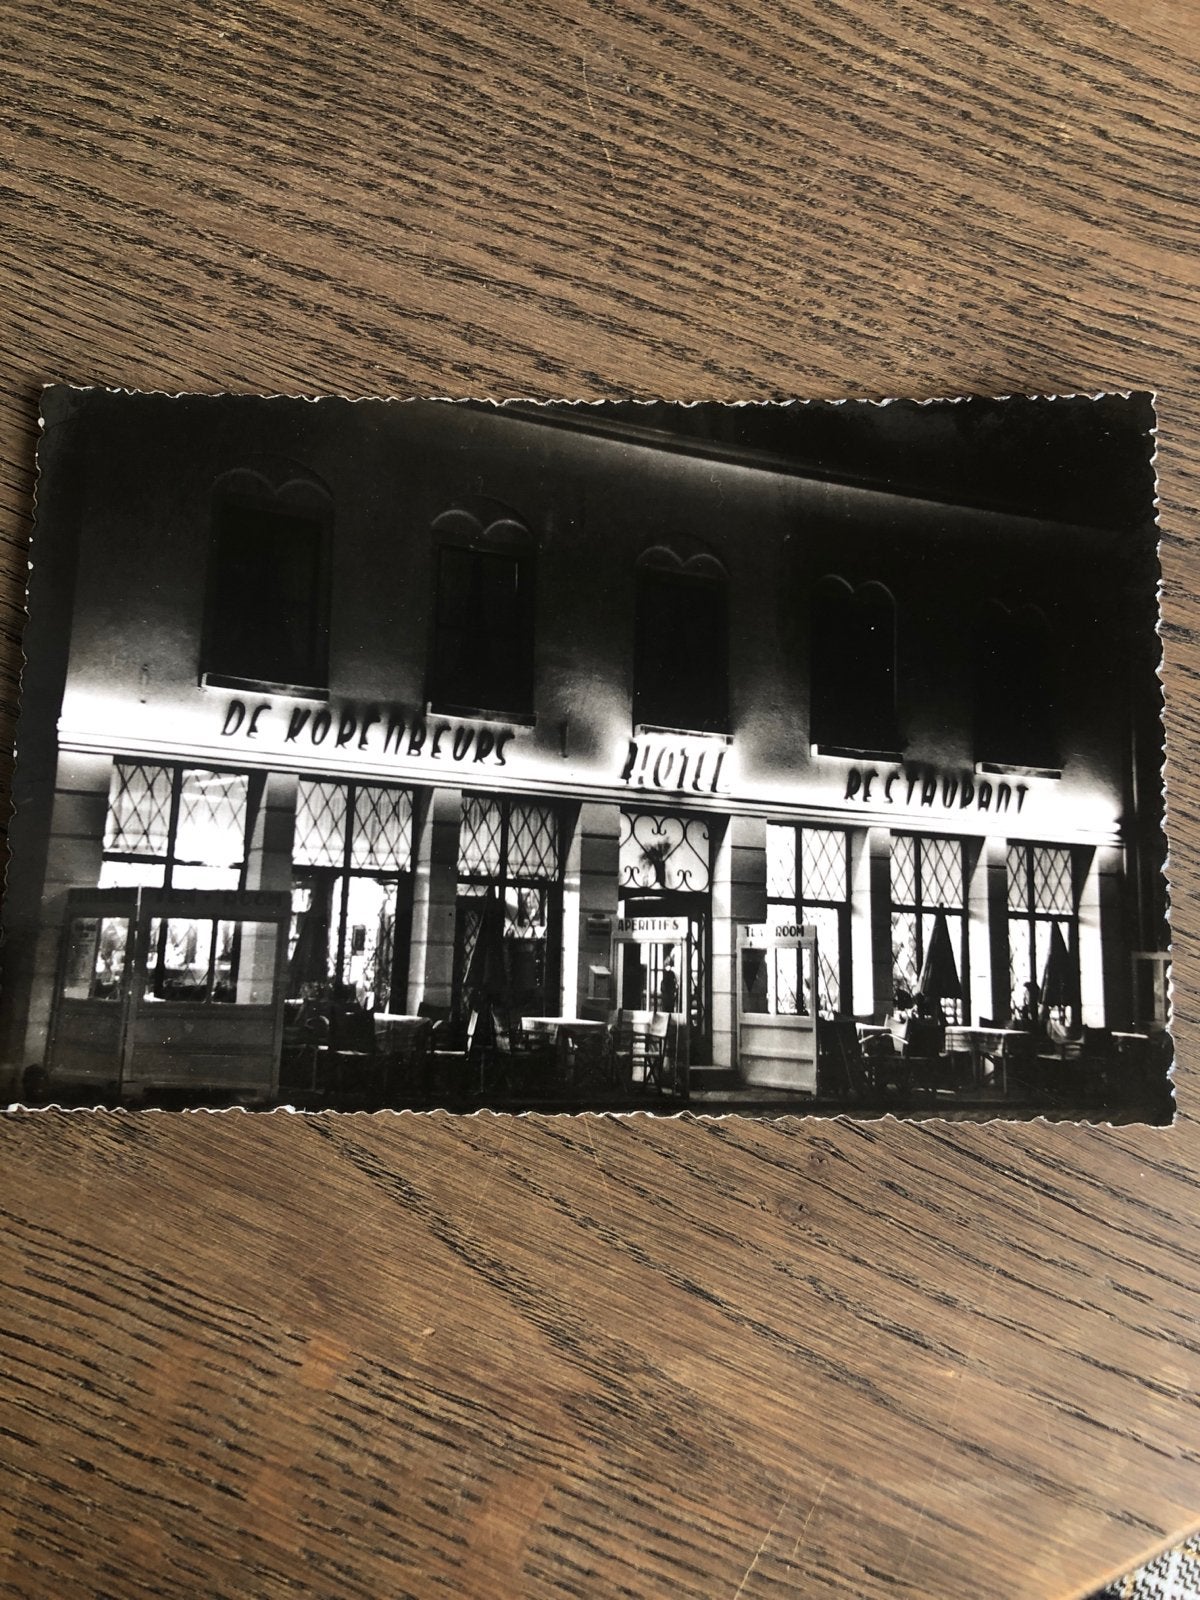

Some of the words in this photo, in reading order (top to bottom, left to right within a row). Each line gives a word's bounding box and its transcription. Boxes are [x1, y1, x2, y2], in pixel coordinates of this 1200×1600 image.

[220, 699, 272, 739] DE
[284, 705, 516, 767] KORENBEURS
[621, 741, 732, 795] HOTEL
[844, 766, 1030, 813] RESTAURANT
[617, 918, 680, 932] APERITIFS
[775, 925, 805, 937] ROOM
